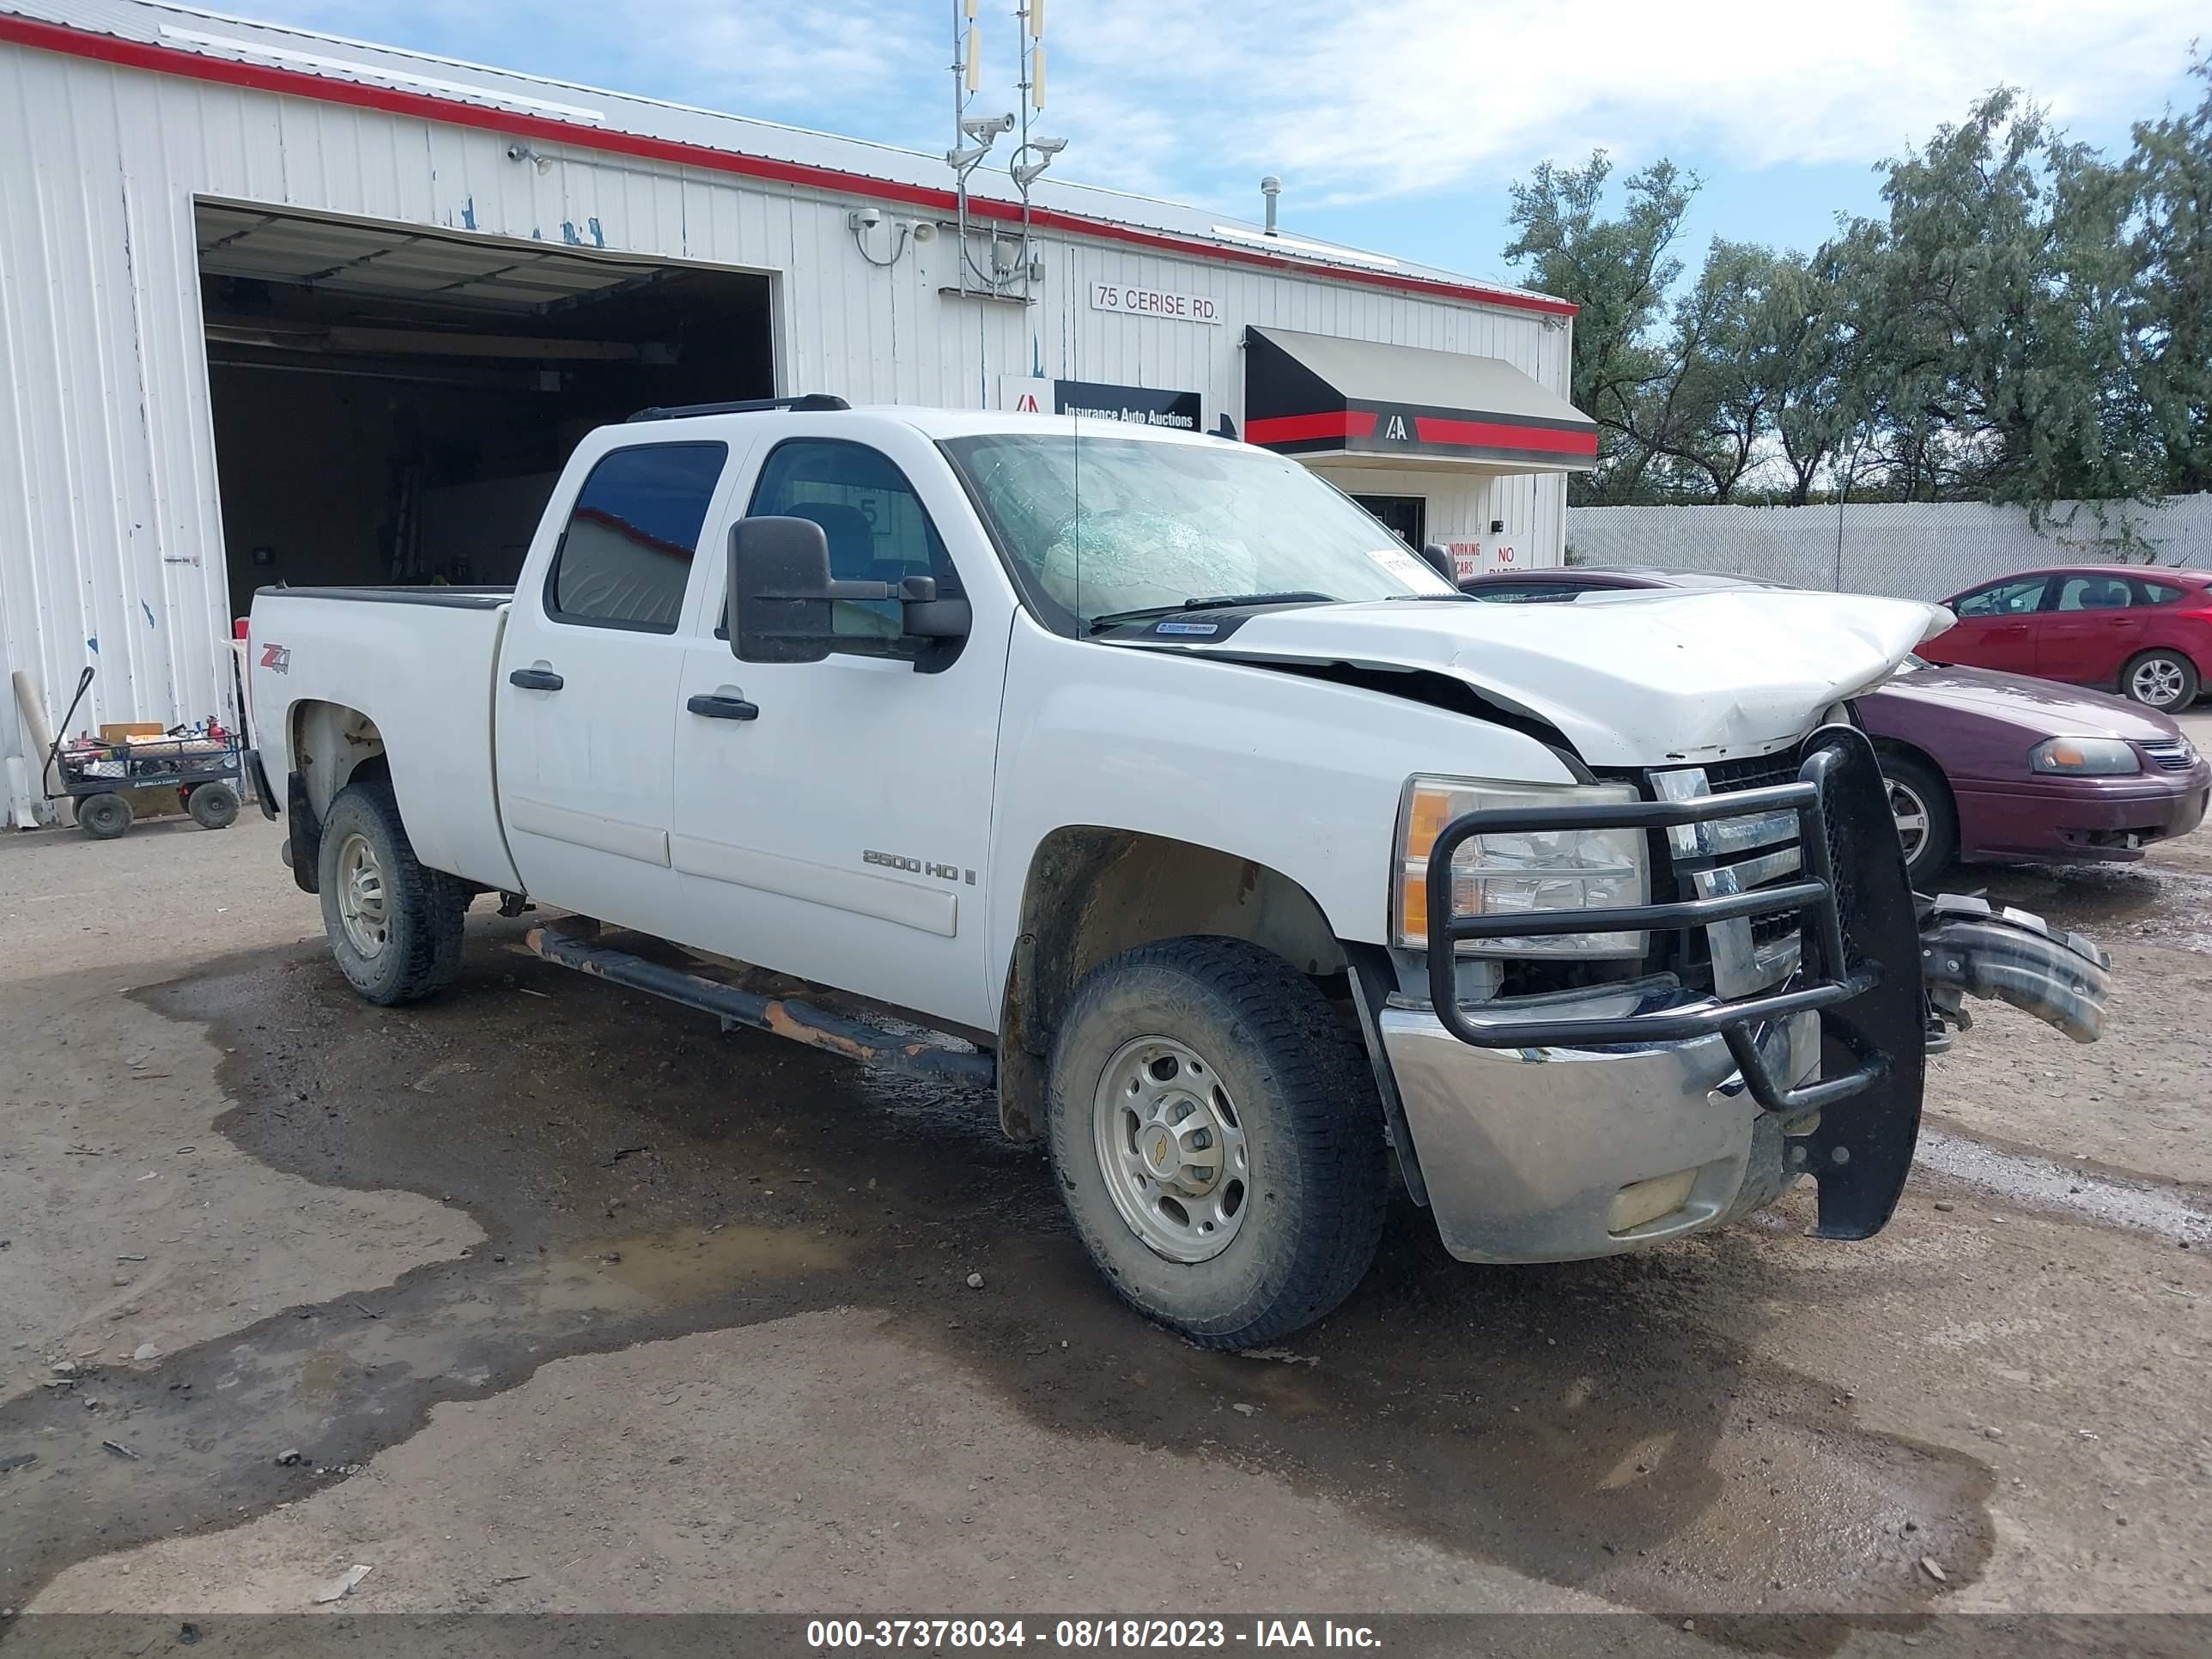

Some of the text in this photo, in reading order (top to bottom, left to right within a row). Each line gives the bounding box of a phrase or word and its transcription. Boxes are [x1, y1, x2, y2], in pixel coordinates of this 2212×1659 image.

[1098, 286, 1218, 320] 75 CERISE RD.
[1065, 402, 1194, 428] Insurance Auto Auctions
[1449, 543, 1480, 557] WORKING
[1498, 547, 1515, 563] NO
[1455, 561, 1474, 574] CARS
[862, 848, 921, 873] 2500
[926, 861, 958, 881] HD
